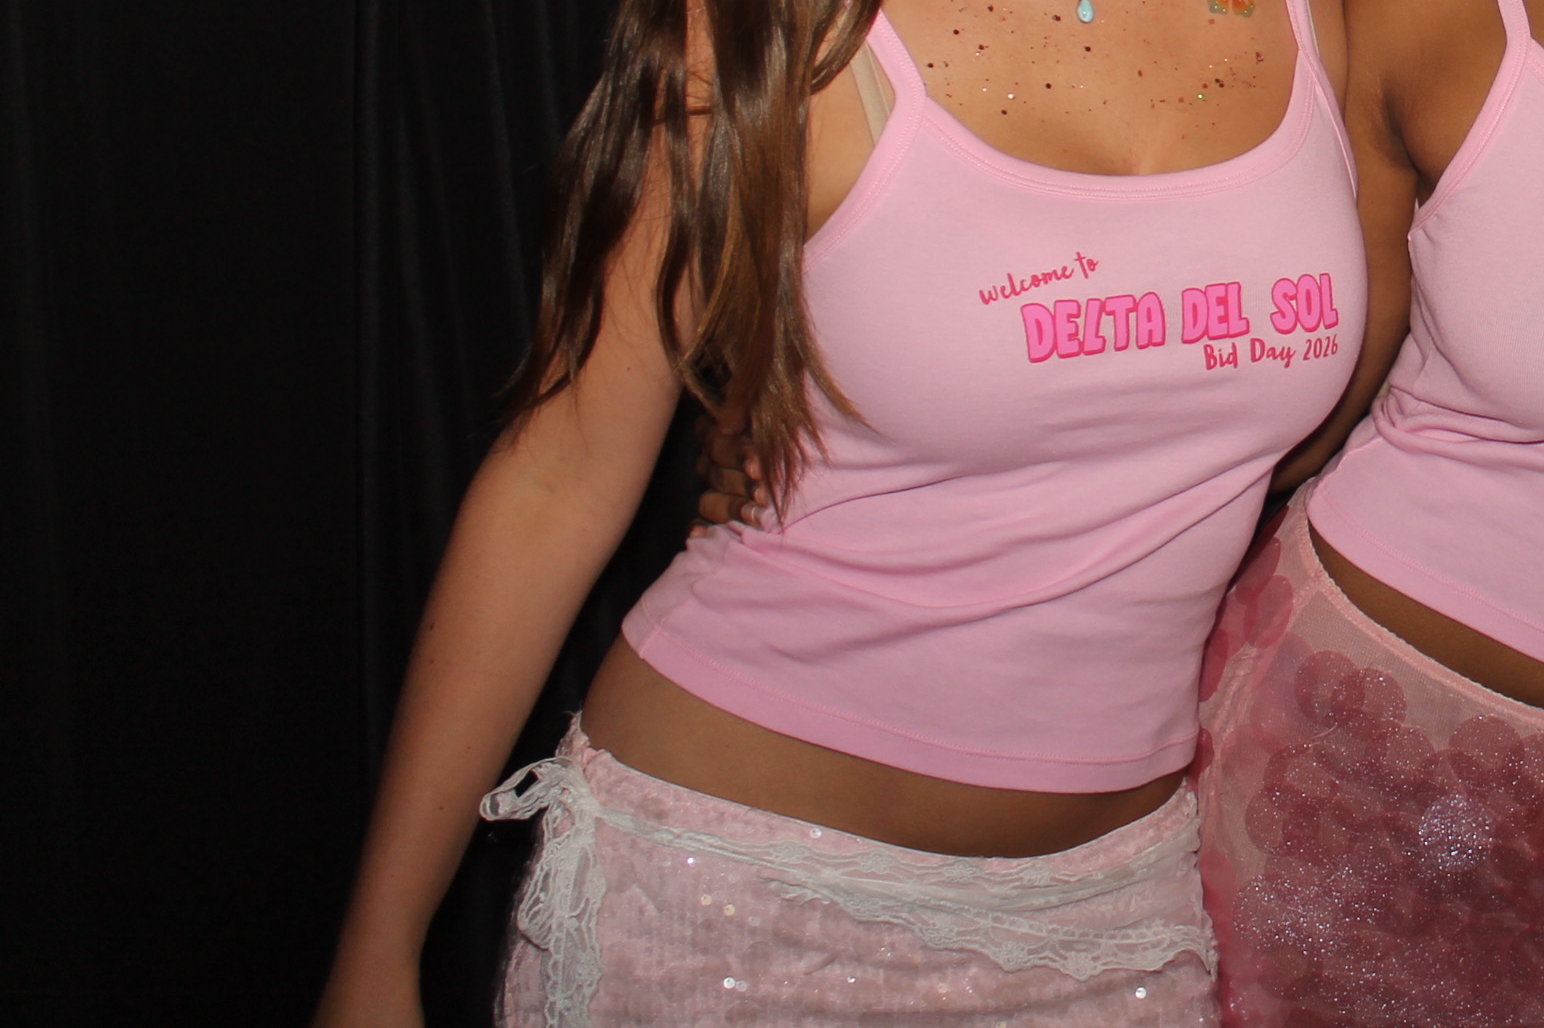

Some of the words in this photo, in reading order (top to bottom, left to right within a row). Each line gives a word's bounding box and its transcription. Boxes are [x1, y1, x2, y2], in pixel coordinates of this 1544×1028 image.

[979, 265, 1074, 305] welcome
[1075, 251, 1099, 279] to
[1020, 292, 1166, 363] DELTA
[1181, 282, 1249, 344] DEL
[1270, 273, 1338, 334] SOL
[1203, 342, 1238, 370] Bid
[1250, 337, 1296, 368] Day
[1302, 334, 1338, 361] 2026
